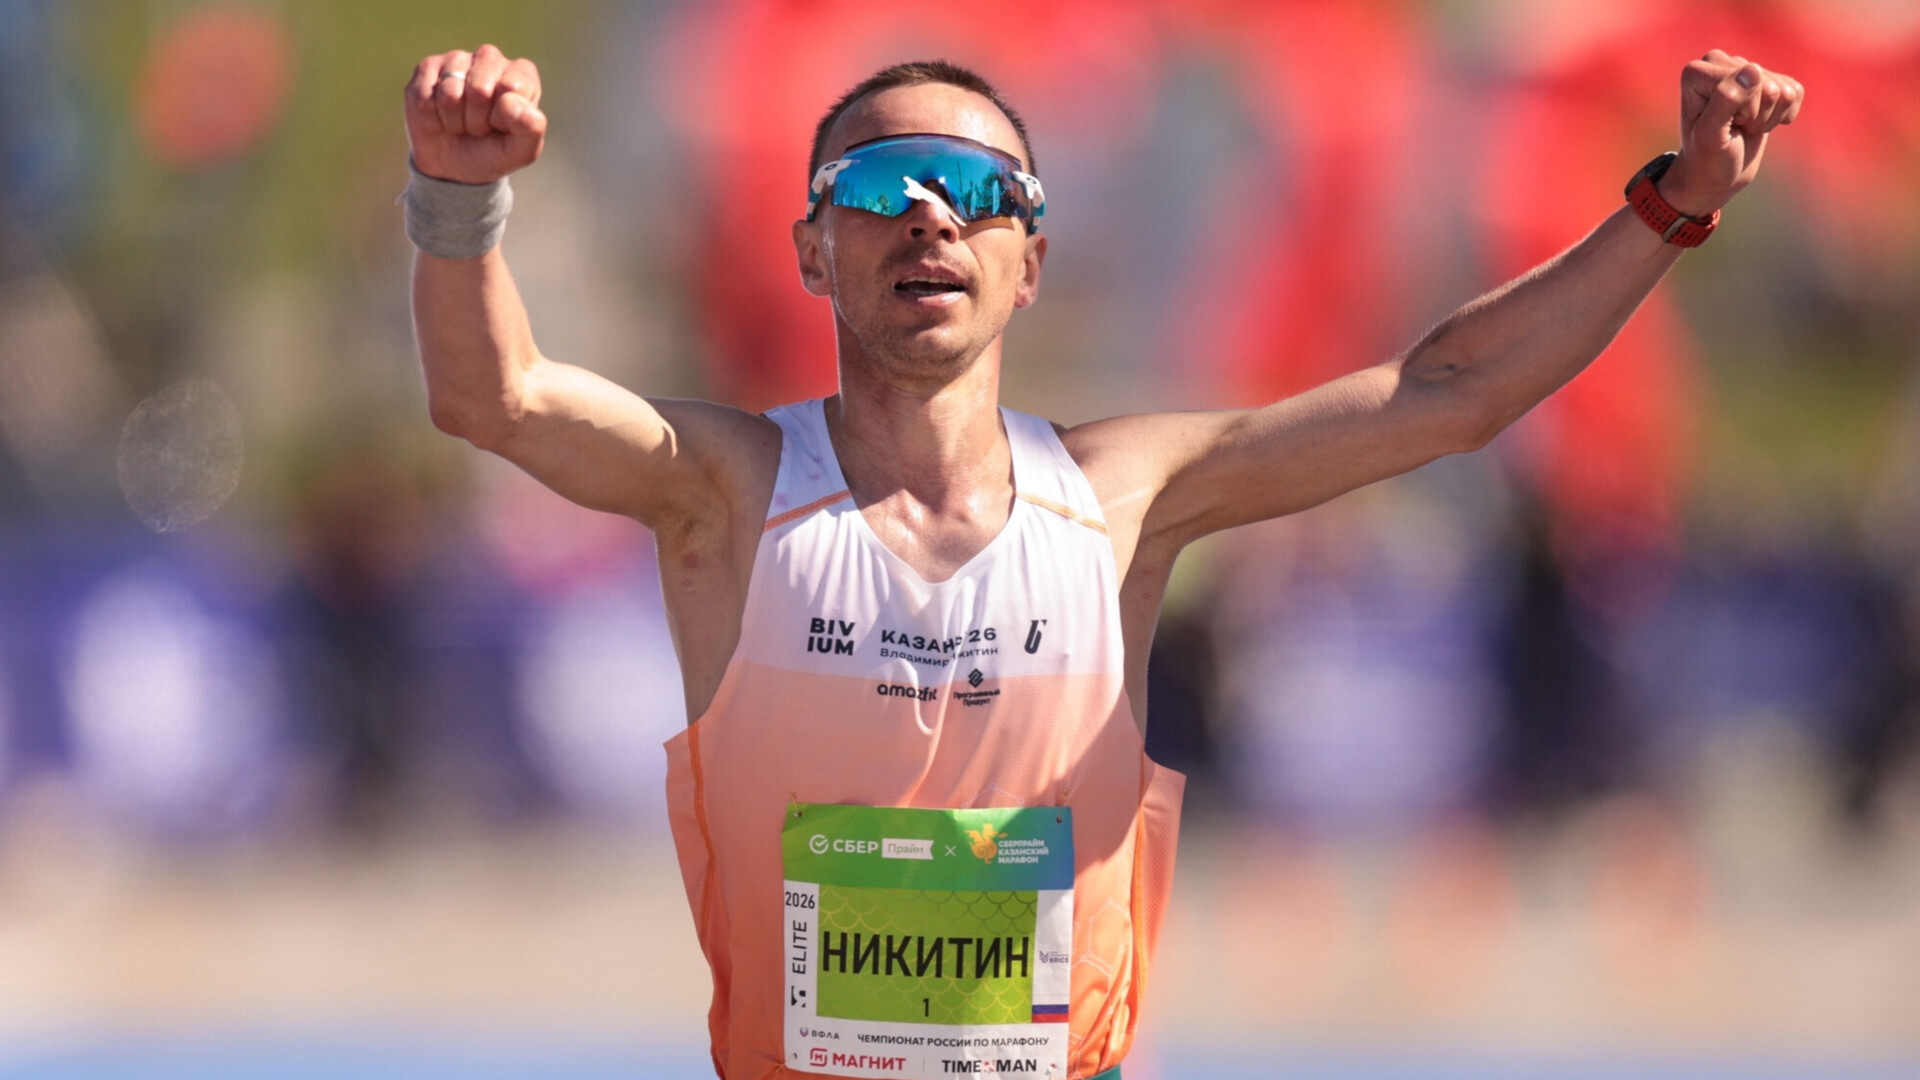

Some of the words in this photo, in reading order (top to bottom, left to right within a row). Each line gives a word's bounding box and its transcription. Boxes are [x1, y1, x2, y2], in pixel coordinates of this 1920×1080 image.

[810, 617, 856, 637] BIV
[807, 636, 854, 656] IUM
[877, 683, 938, 702] amazfit
[963, 698, 991, 707] Продукт
[833, 838, 879, 854] СБЕР
[887, 843, 925, 854] Прайм
[998, 838, 1045, 848] СБЕРПРАЙМ
[998, 847, 1049, 856] КАЗАНСКИЙ
[998, 856, 1039, 864] МАРАФОН
[785, 891, 816, 909] 2026
[792, 920, 808, 975] ELITE
[822, 931, 1029, 979] НИКИТИН
[921, 997, 930, 1017] 1
[857, 1034, 925, 1046] ЧЕМПИОНАТ
[927, 1036, 972, 1047] РОССИИ
[973, 1036, 990, 1047] ПО
[992, 1036, 1049, 1047] МАРАФОНУ
[832, 1052, 906, 1071] МАГНИТ
